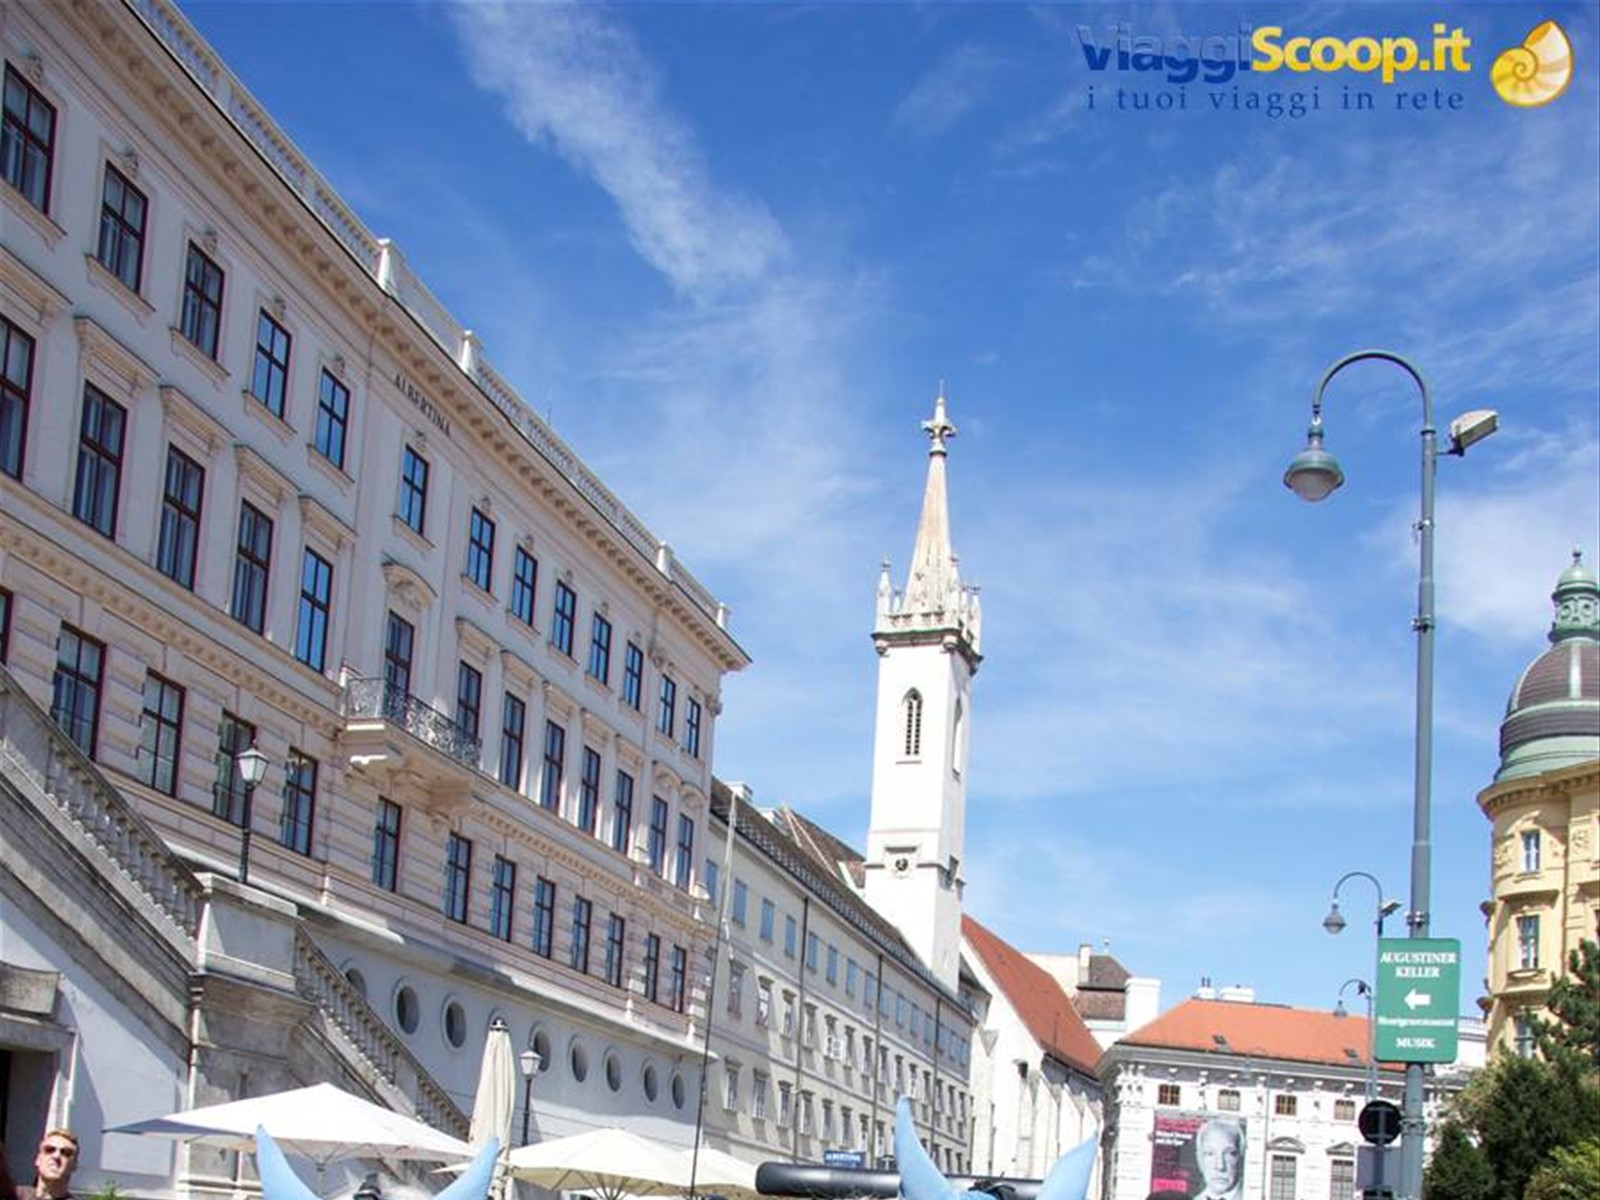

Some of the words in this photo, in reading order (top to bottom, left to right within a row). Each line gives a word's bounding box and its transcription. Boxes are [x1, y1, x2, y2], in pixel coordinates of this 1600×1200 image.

[395, 373, 451, 438] ALBERTINA
[1380, 952, 1458, 964] AUGUSTINER
[1395, 966, 1440, 978] KELLER
[1396, 1037, 1436, 1048] MUSIK
